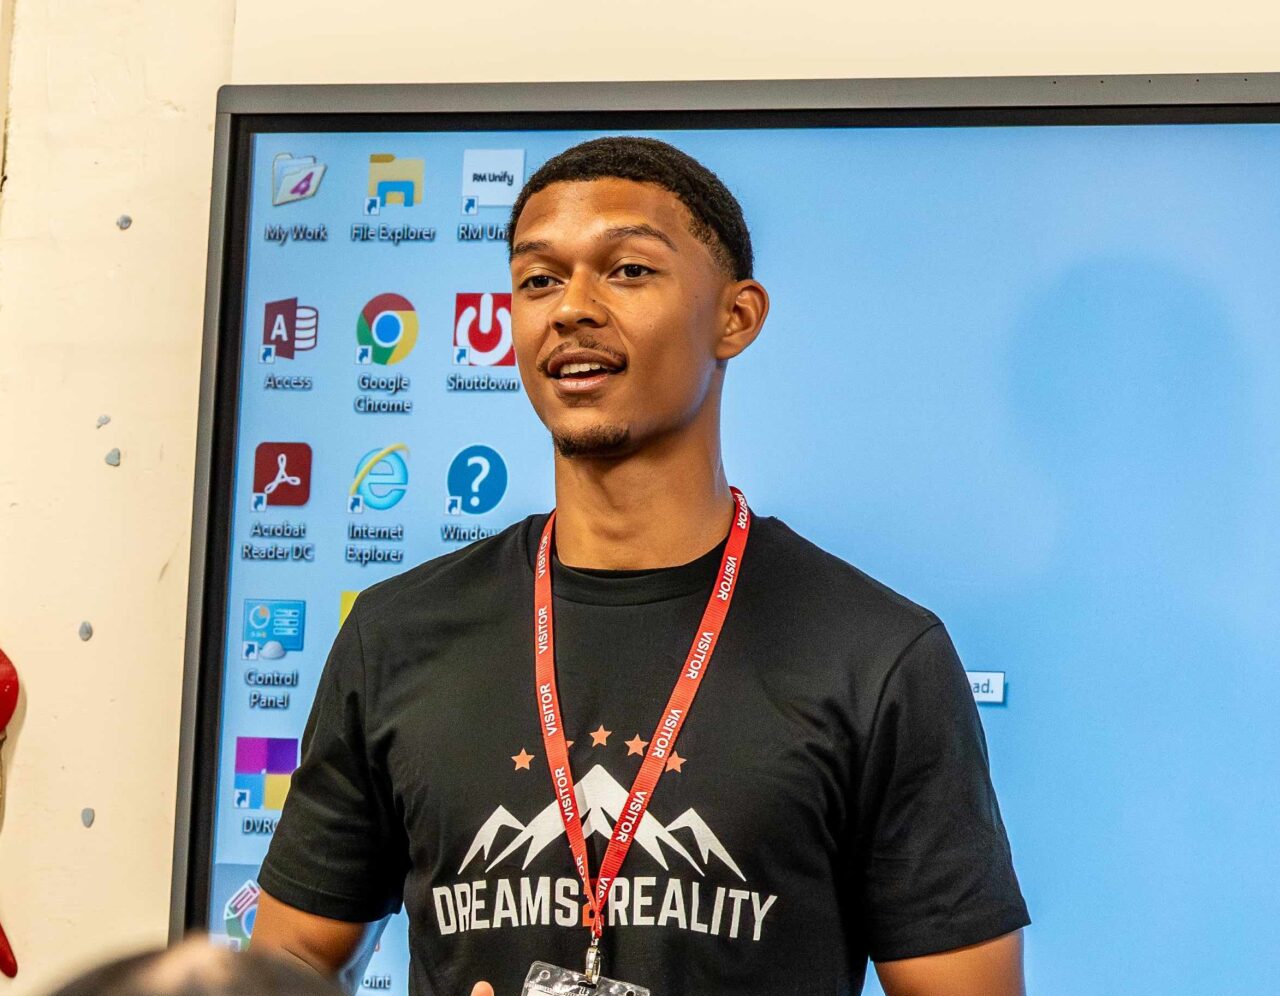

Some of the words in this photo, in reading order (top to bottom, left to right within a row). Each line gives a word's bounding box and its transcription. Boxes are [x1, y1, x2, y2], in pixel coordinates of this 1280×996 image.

[472, 173, 487, 183] RM
[488, 172, 514, 186] Unify
[264, 224, 288, 243] My
[292, 223, 328, 242] Work
[351, 224, 375, 241] File
[379, 224, 436, 244] Explorer
[457, 224, 483, 241] RM
[486, 224, 510, 241] Uni
[264, 373, 312, 390] Access
[358, 373, 410, 393] Google
[447, 374, 519, 391] Shutdown
[355, 395, 412, 412] Chrome
[250, 522, 306, 538] Acrobat
[348, 523, 403, 540] Internet
[242, 544, 289, 560] Reader
[292, 544, 315, 561] DC
[346, 544, 404, 564] Explorer
[717, 555, 738, 601] VISITOR
[538, 605, 548, 655] VISITOR
[685, 631, 714, 680] VISITOR
[245, 670, 298, 686] Control
[972, 678, 994, 694] ad.
[250, 692, 289, 708] Panel
[540, 683, 558, 736] VISITOR
[651, 708, 683, 759] VISITOR
[554, 766, 575, 822] VISITOR
[615, 791, 648, 843] VISITOR
[362, 974, 391, 989] oint
